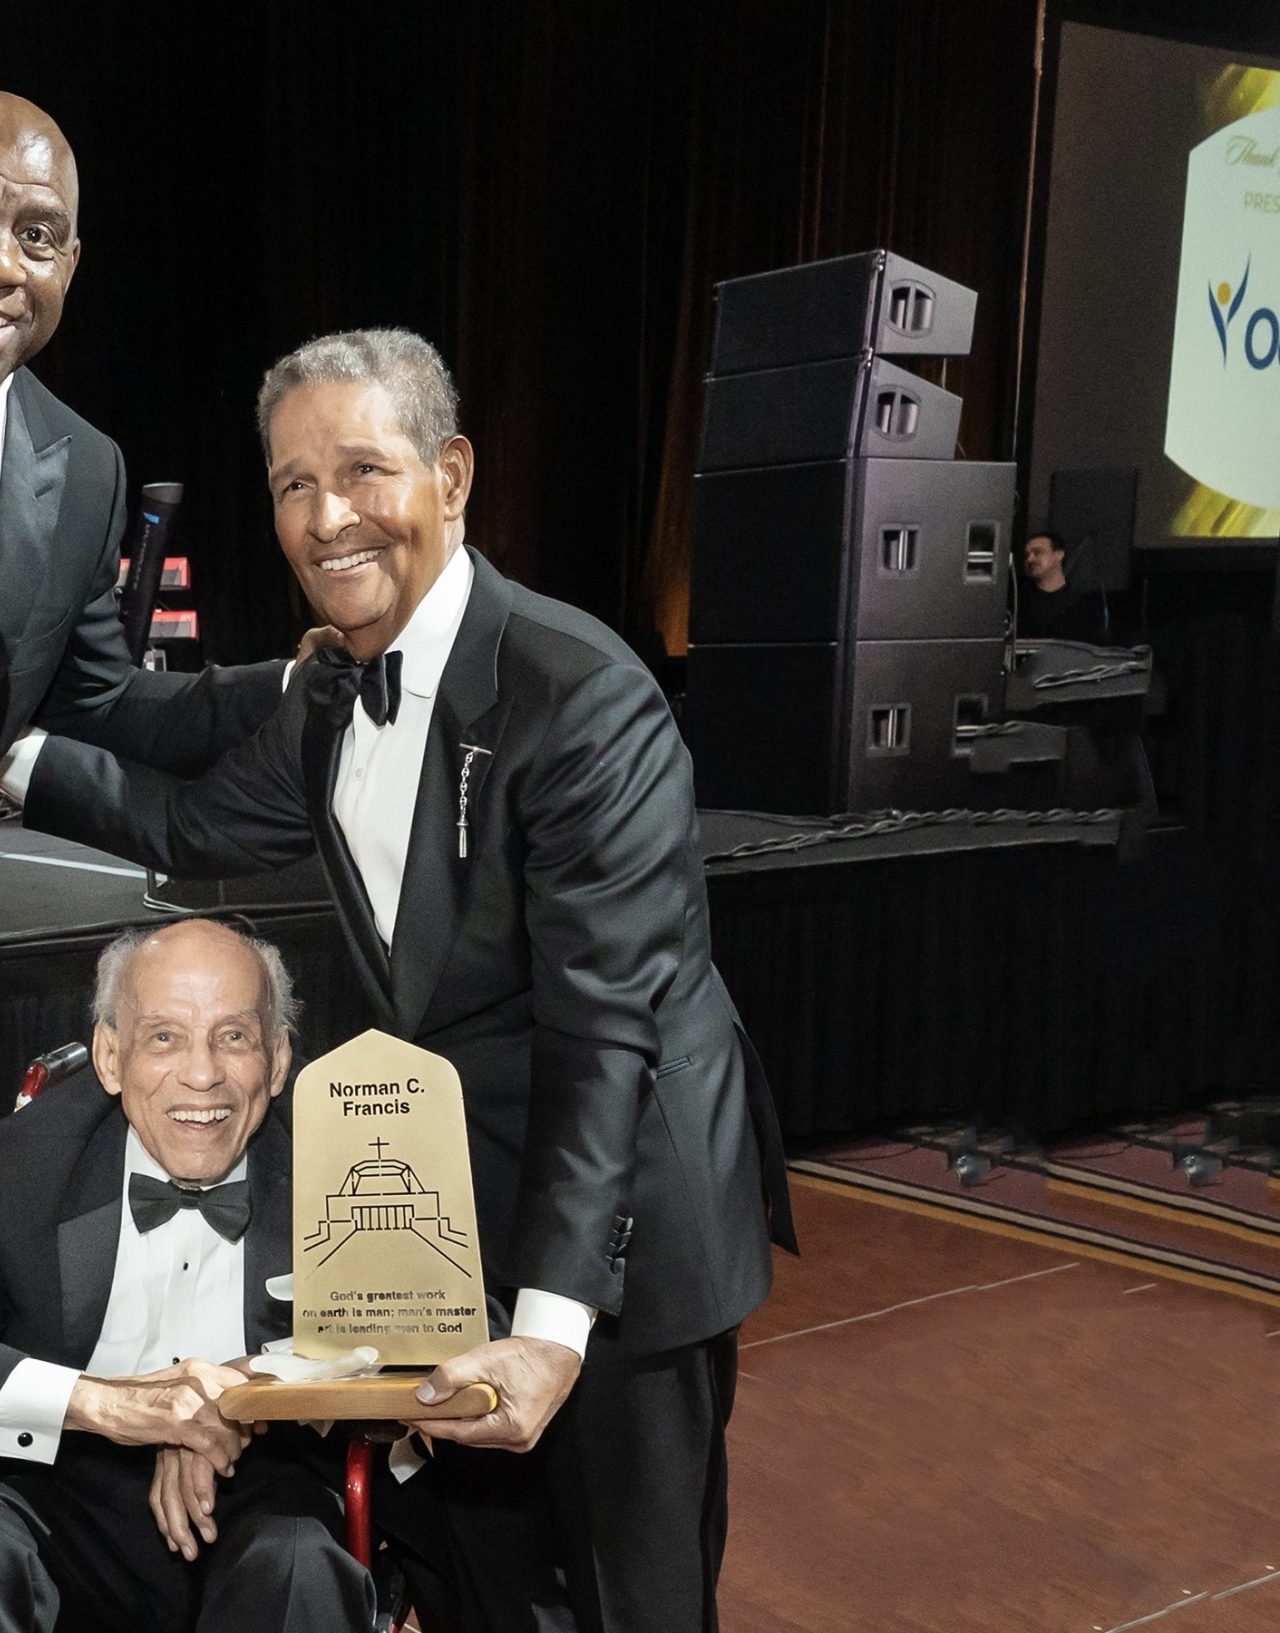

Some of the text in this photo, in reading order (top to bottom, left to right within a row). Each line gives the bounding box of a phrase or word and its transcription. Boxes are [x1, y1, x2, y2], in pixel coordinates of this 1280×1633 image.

[1208, 248, 1280, 371] Yo
[329, 1078, 425, 1098] Norman C.
[343, 1099, 410, 1117] Francis
[330, 1289, 446, 1303] God's greatest work
[319, 1307, 349, 1318] earth
[352, 1307, 363, 1318] is
[365, 1308, 395, 1318] man;
[397, 1306, 433, 1317] man's
[435, 1306, 477, 1317] master
[349, 1322, 391, 1335] leading
[422, 1323, 435, 1333] to
[437, 1322, 463, 1333] God
